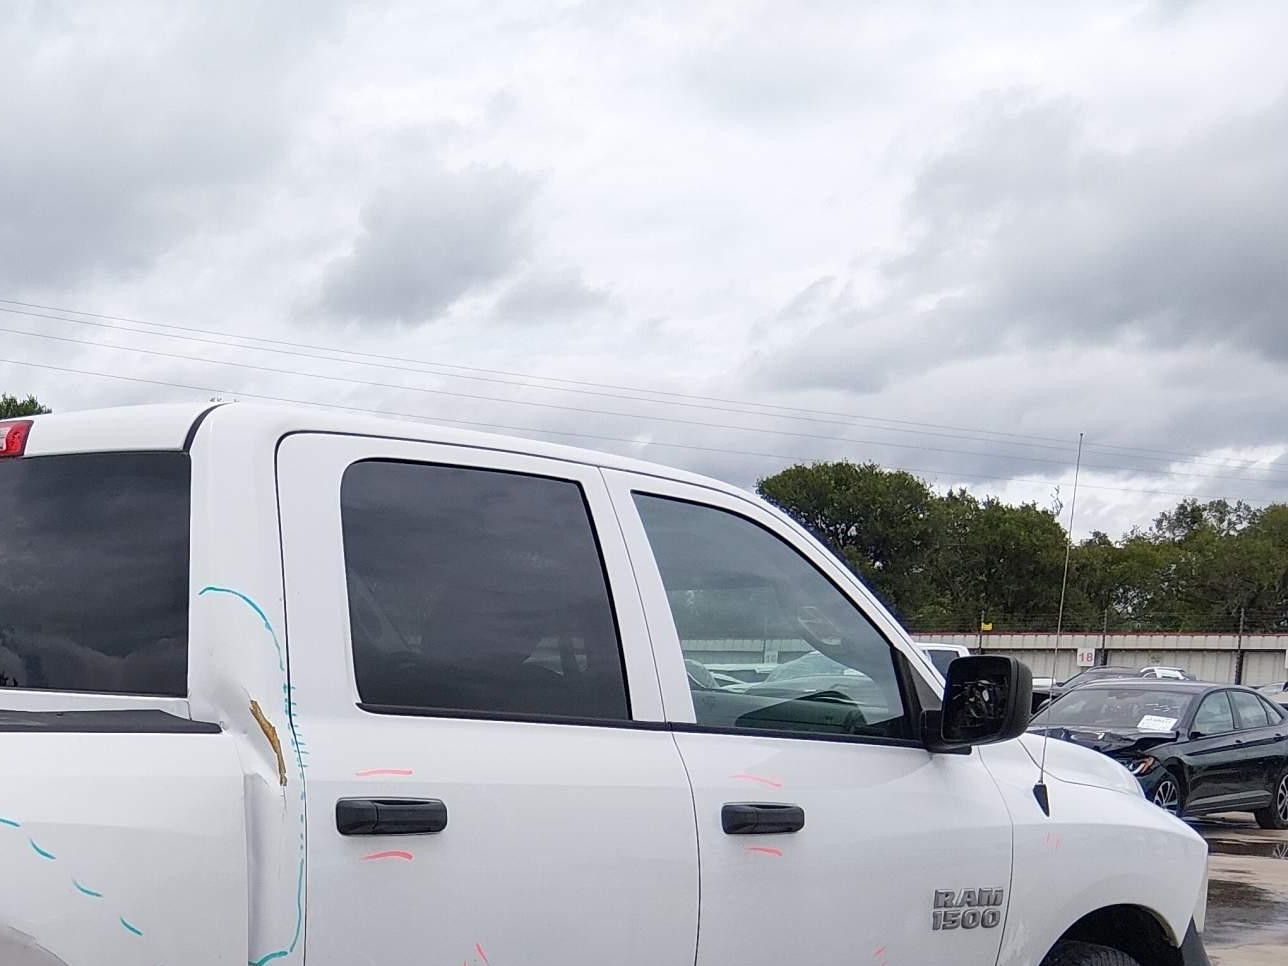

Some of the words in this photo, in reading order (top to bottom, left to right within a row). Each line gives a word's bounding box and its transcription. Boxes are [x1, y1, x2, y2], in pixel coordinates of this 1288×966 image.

[1078, 652, 1094, 663] 18
[934, 888, 1004, 908] RAM
[932, 908, 1002, 931] 1500
